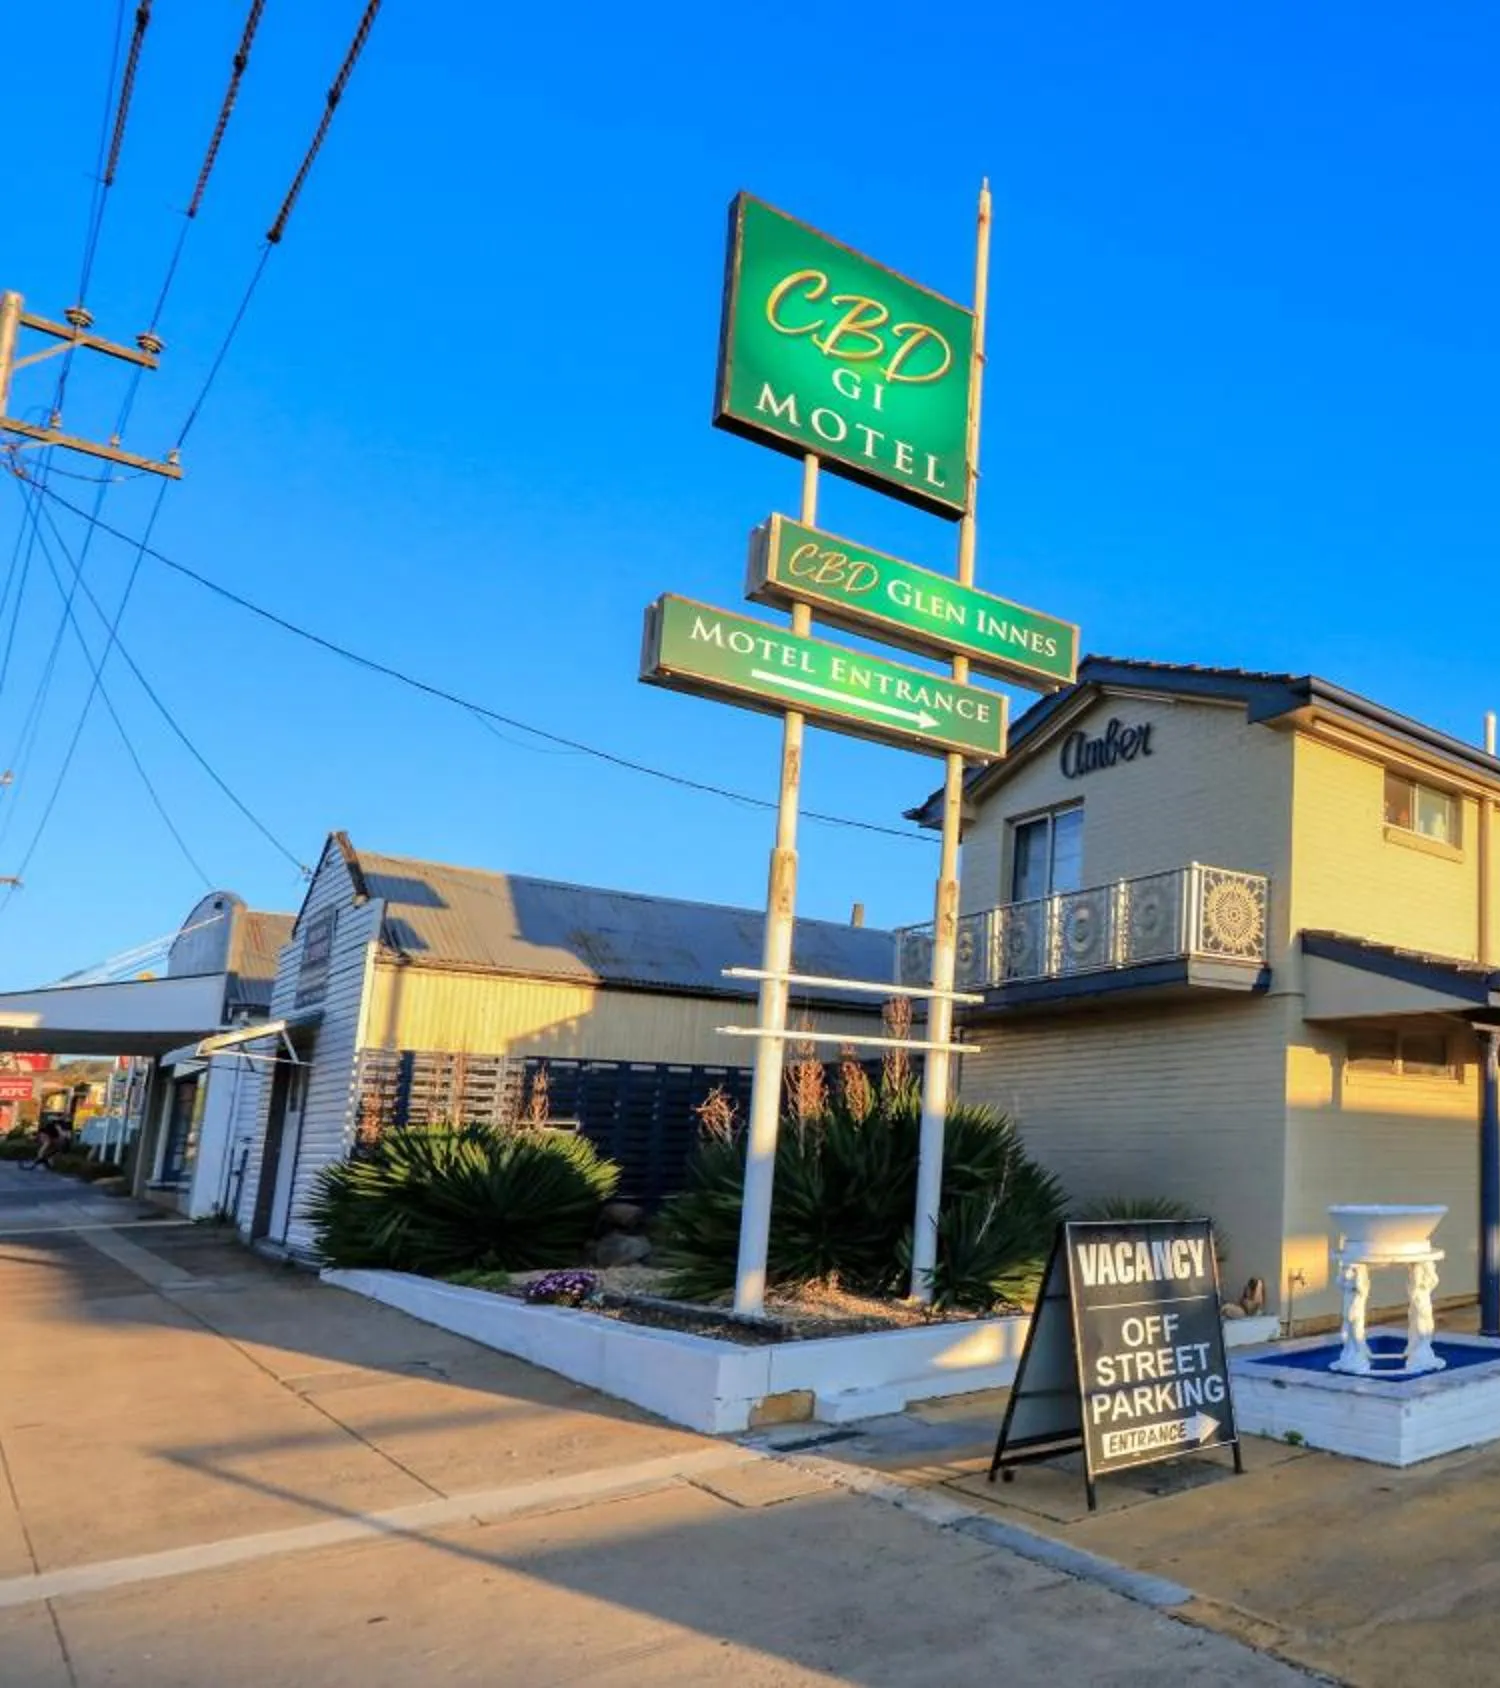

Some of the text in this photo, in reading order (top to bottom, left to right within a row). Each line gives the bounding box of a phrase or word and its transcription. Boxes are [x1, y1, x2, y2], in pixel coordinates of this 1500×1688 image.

[766, 269, 952, 383] CBD
[832, 367, 885, 412] GI
[755, 381, 946, 488] MOTEL
[788, 543, 1057, 658] CBD GLEN INNES
[690, 616, 990, 723] MOTEL ENTRANCE
[1077, 1239, 1205, 1287] VACANCY
[1121, 1313, 1179, 1347] OFF
[1096, 1343, 1211, 1387] STREET
[1092, 1374, 1225, 1424] PARKING
[1109, 1421, 1187, 1449] ENTRANCE
